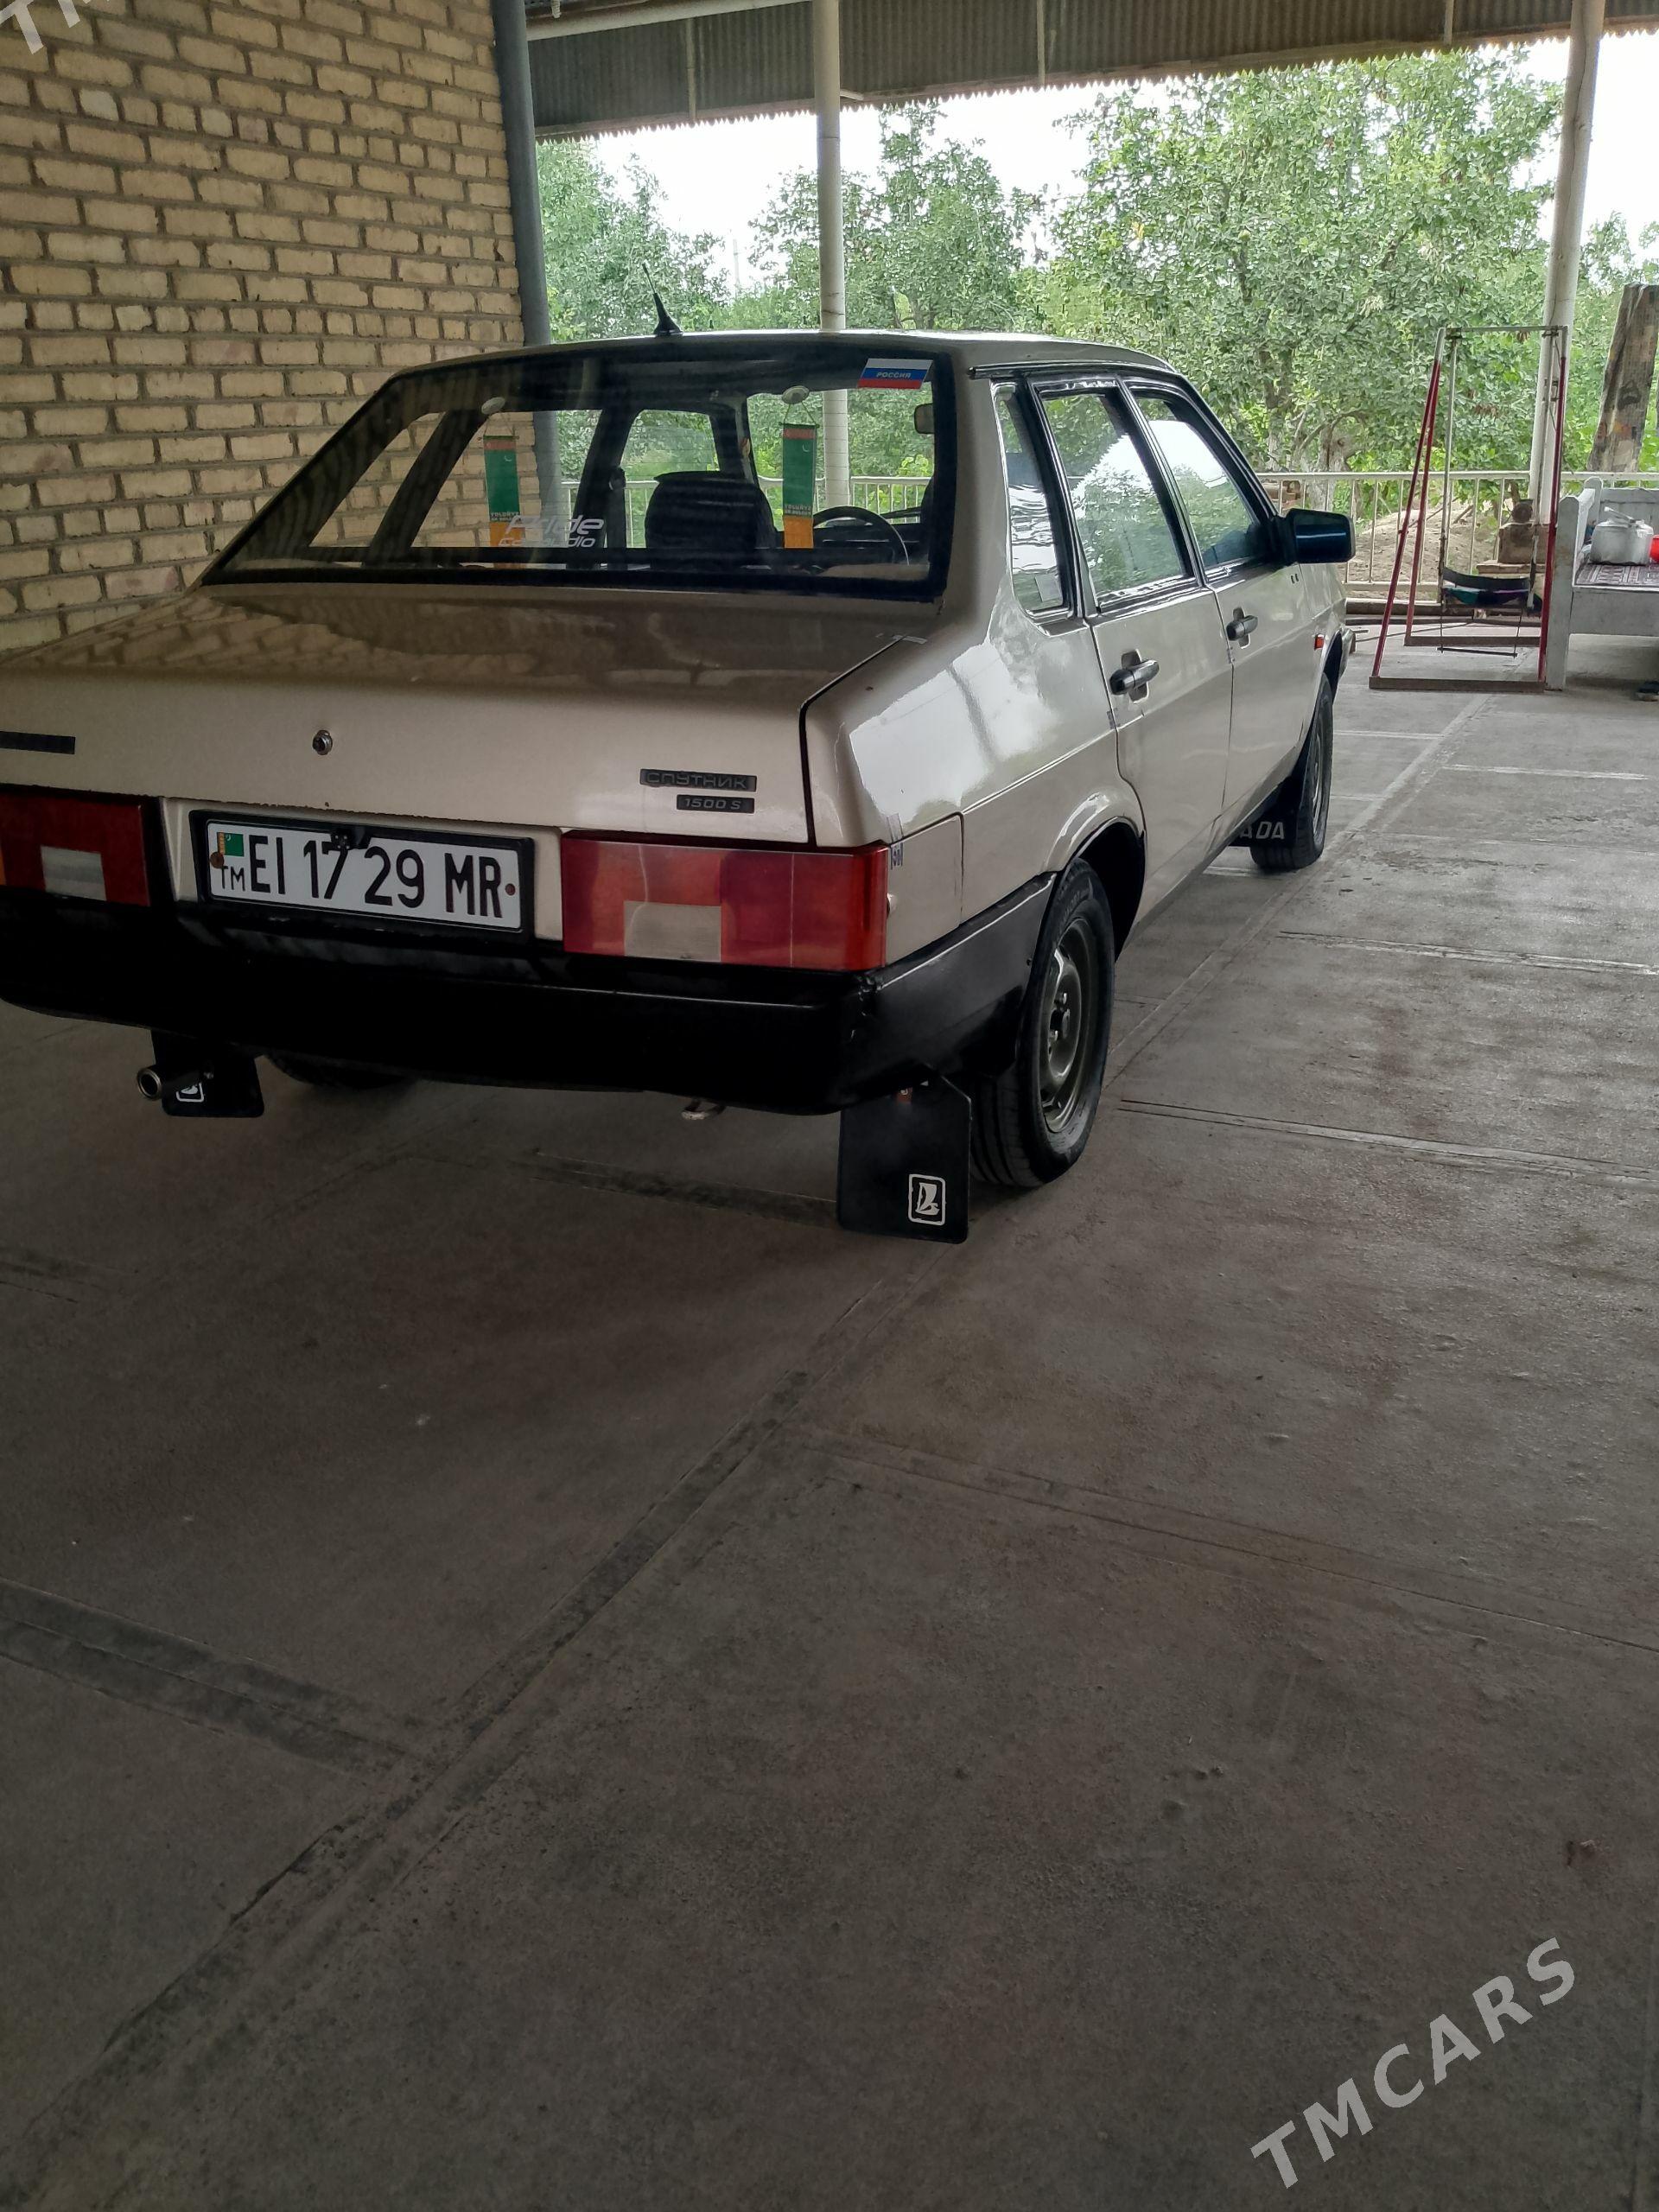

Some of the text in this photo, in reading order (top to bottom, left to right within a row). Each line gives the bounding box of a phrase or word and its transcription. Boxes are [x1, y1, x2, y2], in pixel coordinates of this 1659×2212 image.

[646, 772, 747, 789] СПУТНИК
[683, 798, 741, 810] 1500 S
[220, 865, 246, 892] TM
[444, 853, 504, 918] MR
